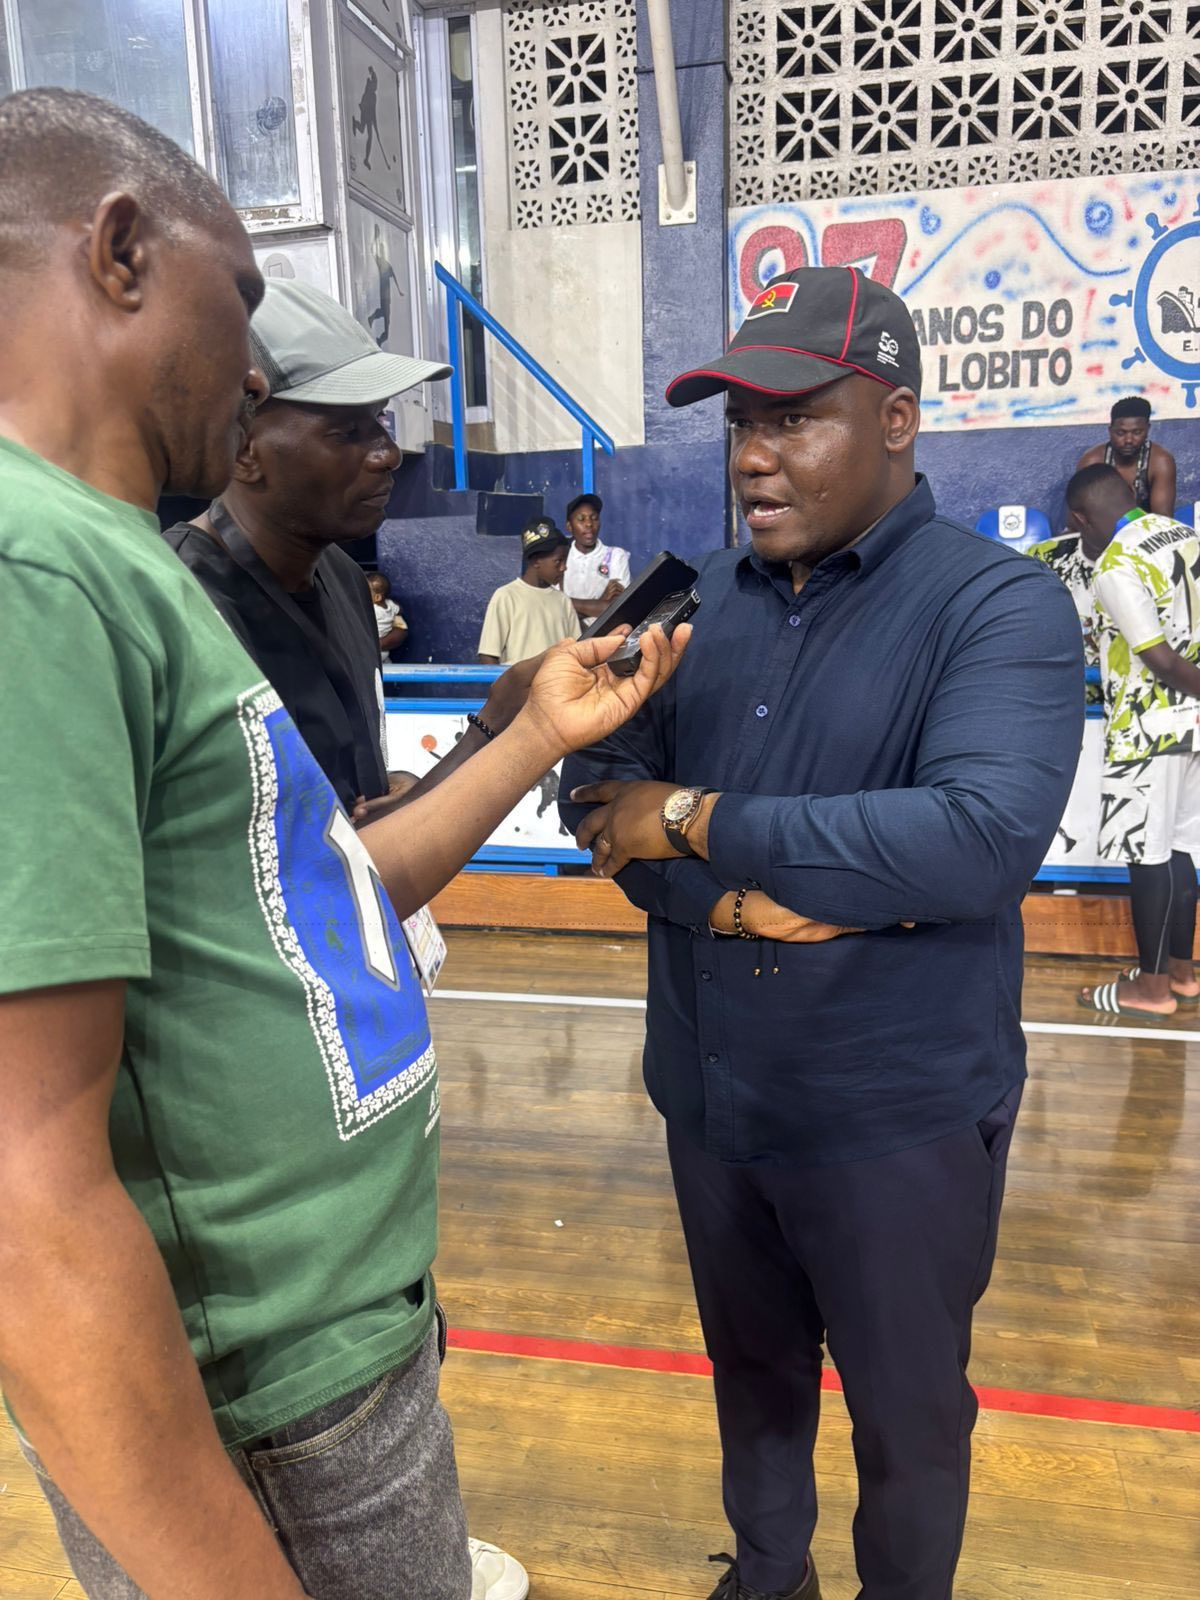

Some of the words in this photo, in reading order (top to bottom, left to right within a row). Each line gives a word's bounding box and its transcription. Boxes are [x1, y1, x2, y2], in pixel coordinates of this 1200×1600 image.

[911, 303, 1004, 346] ANOS
[1021, 298, 1074, 340] DO
[938, 347, 1073, 392] LOBITO
